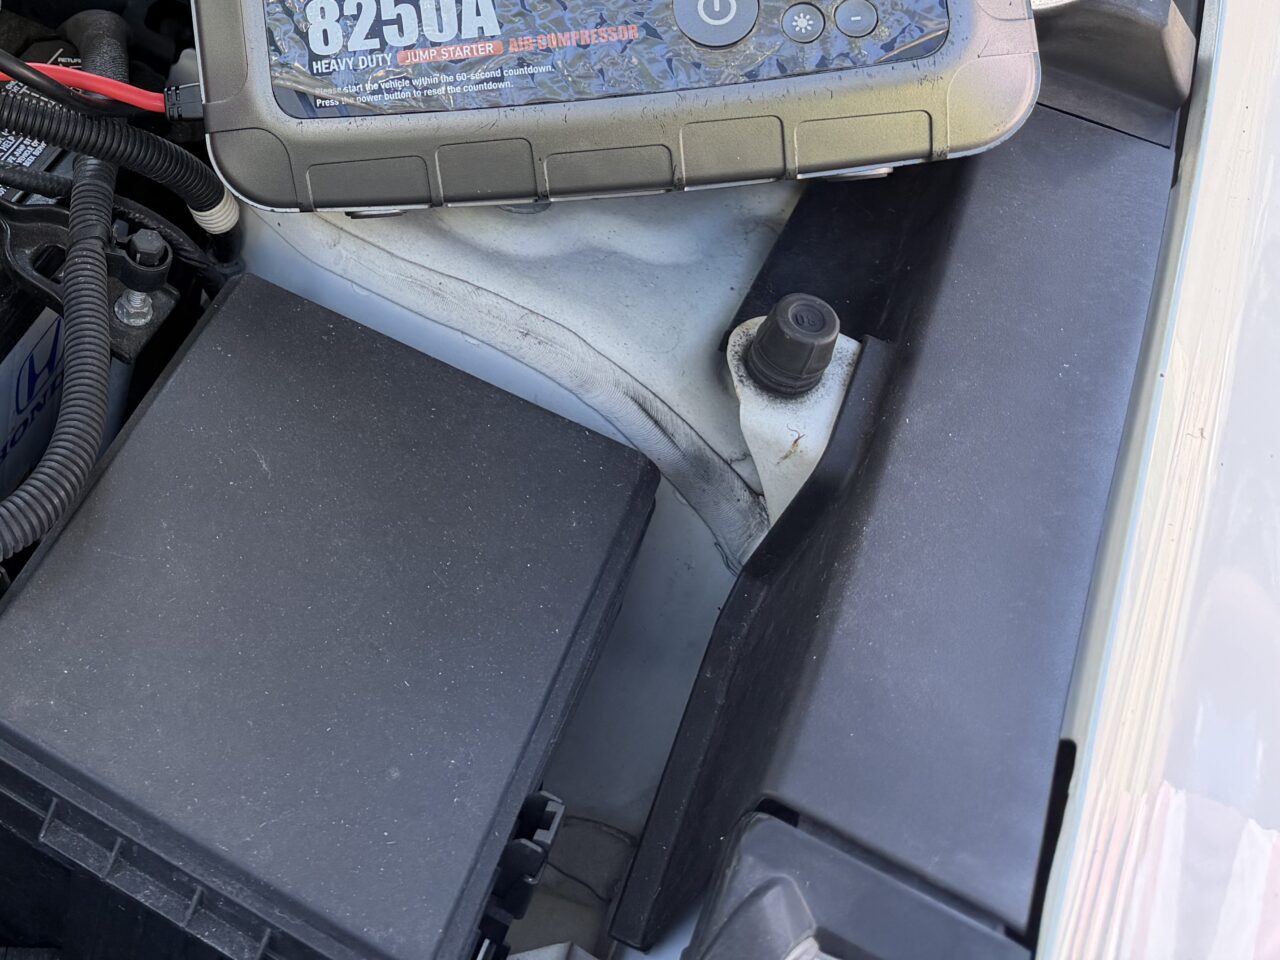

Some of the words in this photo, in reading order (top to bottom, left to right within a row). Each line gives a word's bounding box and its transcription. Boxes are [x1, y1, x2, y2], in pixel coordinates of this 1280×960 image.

[313, 57, 354, 74] HEAVY
[359, 53, 392, 70] DUTY
[405, 47, 437, 63] JUMP
[441, 42, 494, 60] STARTER
[509, 36, 534, 52] AIR
[537, 25, 640, 49] COMPRESSOR
[343, 84, 364, 93] start
[380, 79, 410, 90] vehicle
[412, 76, 439, 87] within
[440, 74, 454, 84] the
[455, 69, 501, 82] 60-second
[503, 64, 555, 77] countdown.
[316, 98, 340, 108] Press
[356, 94, 382, 104] power
[384, 91, 411, 100] button
[413, 90, 421, 98] to
[423, 86, 445, 96] reset
[447, 84, 461, 94] the
[463, 80, 514, 93] countdown.
